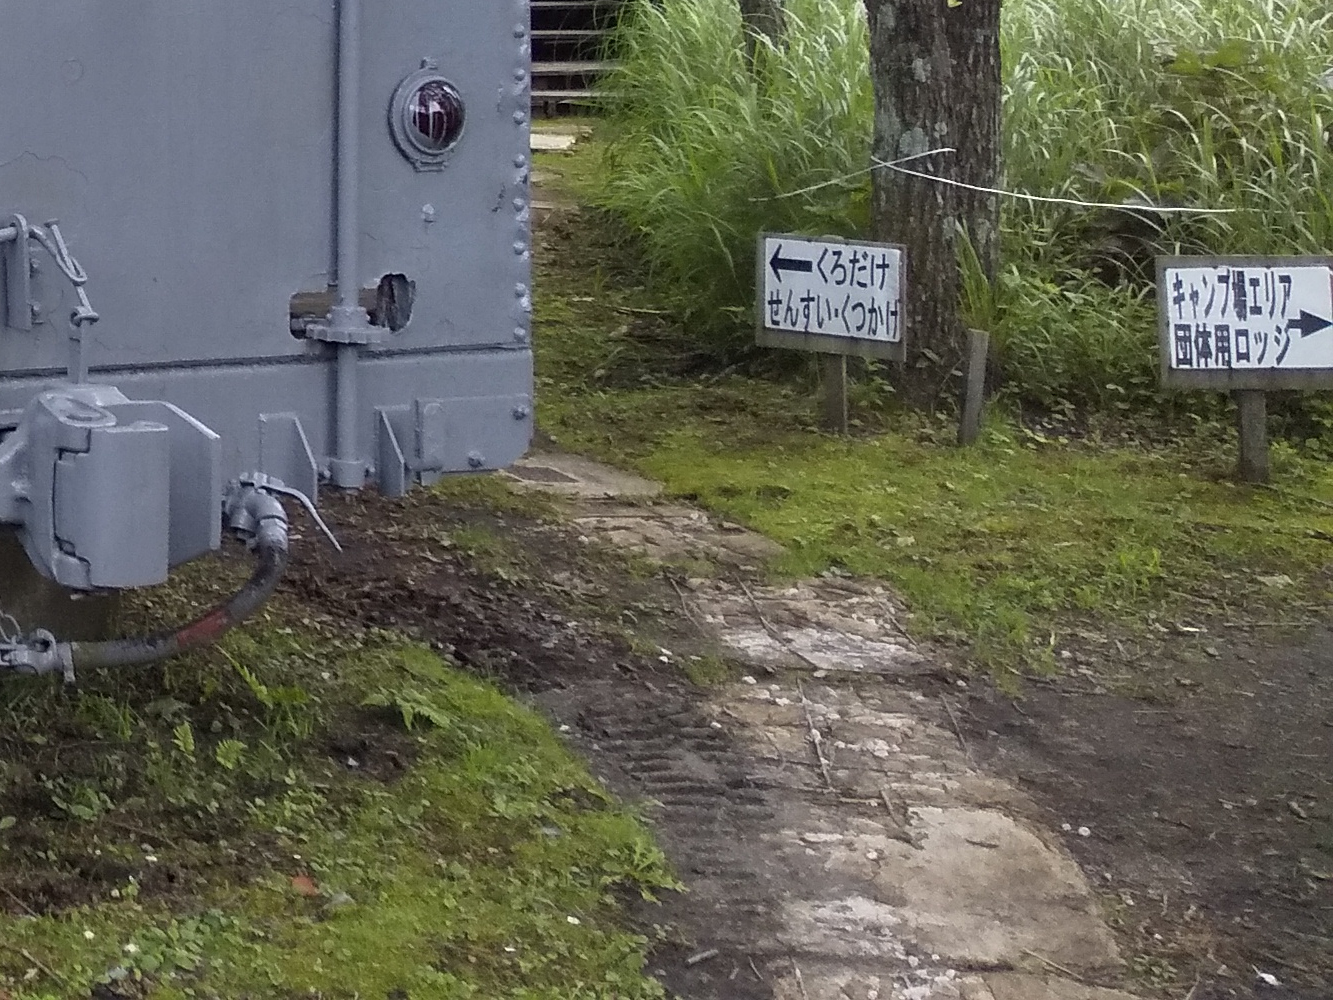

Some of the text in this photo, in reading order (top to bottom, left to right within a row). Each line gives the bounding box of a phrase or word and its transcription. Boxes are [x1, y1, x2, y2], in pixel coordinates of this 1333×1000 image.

[817, 248, 890, 290] くろだけ
[1174, 322, 1290, 368] 団体用ロッジ
